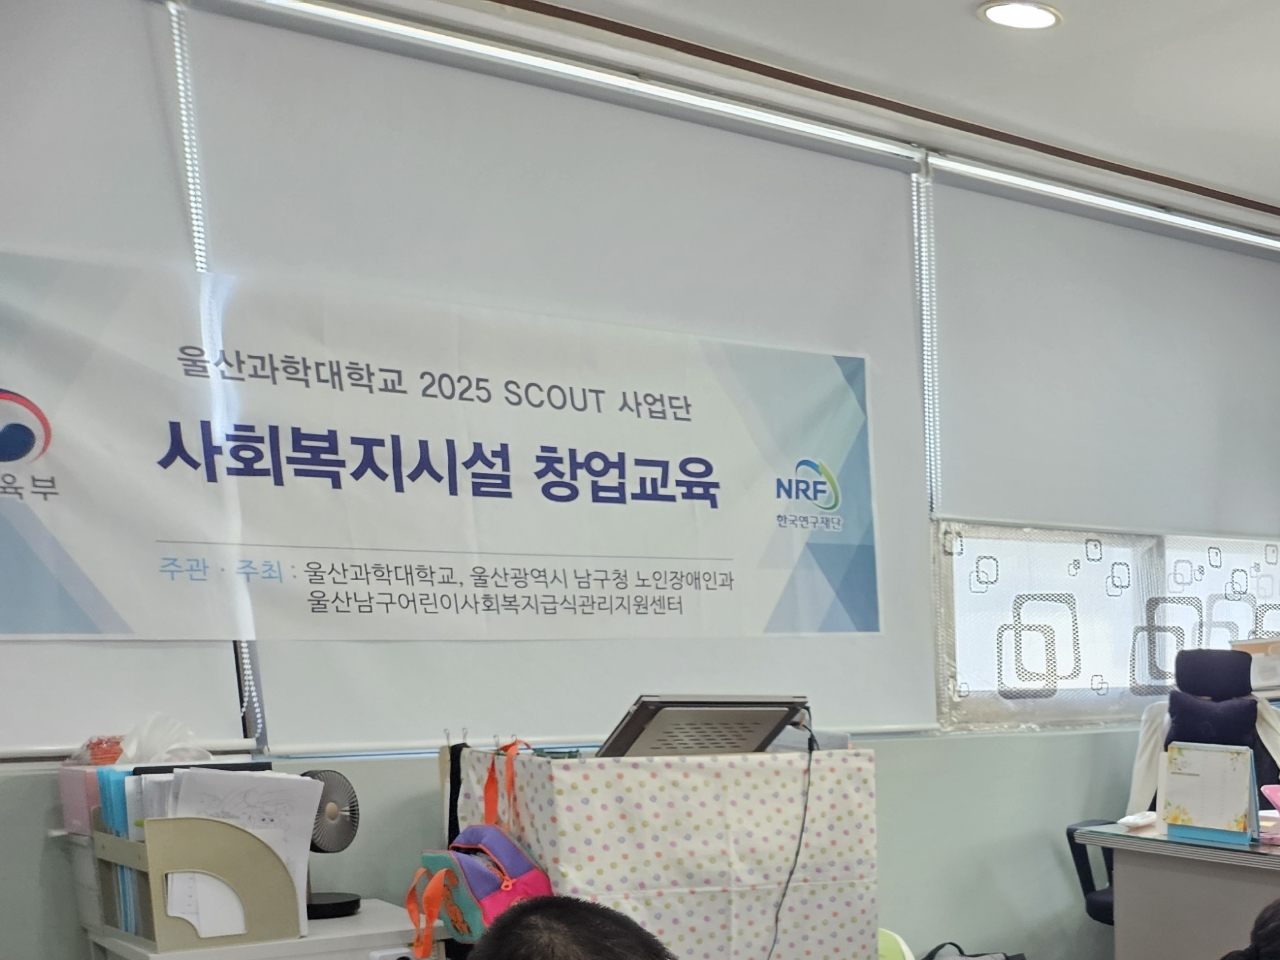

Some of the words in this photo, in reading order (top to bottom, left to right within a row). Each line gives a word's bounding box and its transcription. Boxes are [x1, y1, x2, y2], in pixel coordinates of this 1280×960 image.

[177, 345, 408, 394] 울산과학대학교
[419, 371, 492, 403] 2025
[504, 380, 606, 413] SCOUT
[618, 391, 692, 422] 사업단
[157, 420, 513, 499] 사회복지시설
[534, 445, 720, 509] 창업교육
[776, 478, 827, 501] NRF
[776, 514, 842, 531] 한국연구재단
[159, 557, 209, 581] 주관
[235, 559, 283, 583] 주최
[303, 561, 463, 588] 울산과학대학교,
[469, 566, 568, 589] 울산광역시
[573, 568, 628, 590] 남구청
[634, 570, 735, 592] 노인장애인과
[306, 590, 684, 616] 울산남구어린이사회복지급식관리지원센터
